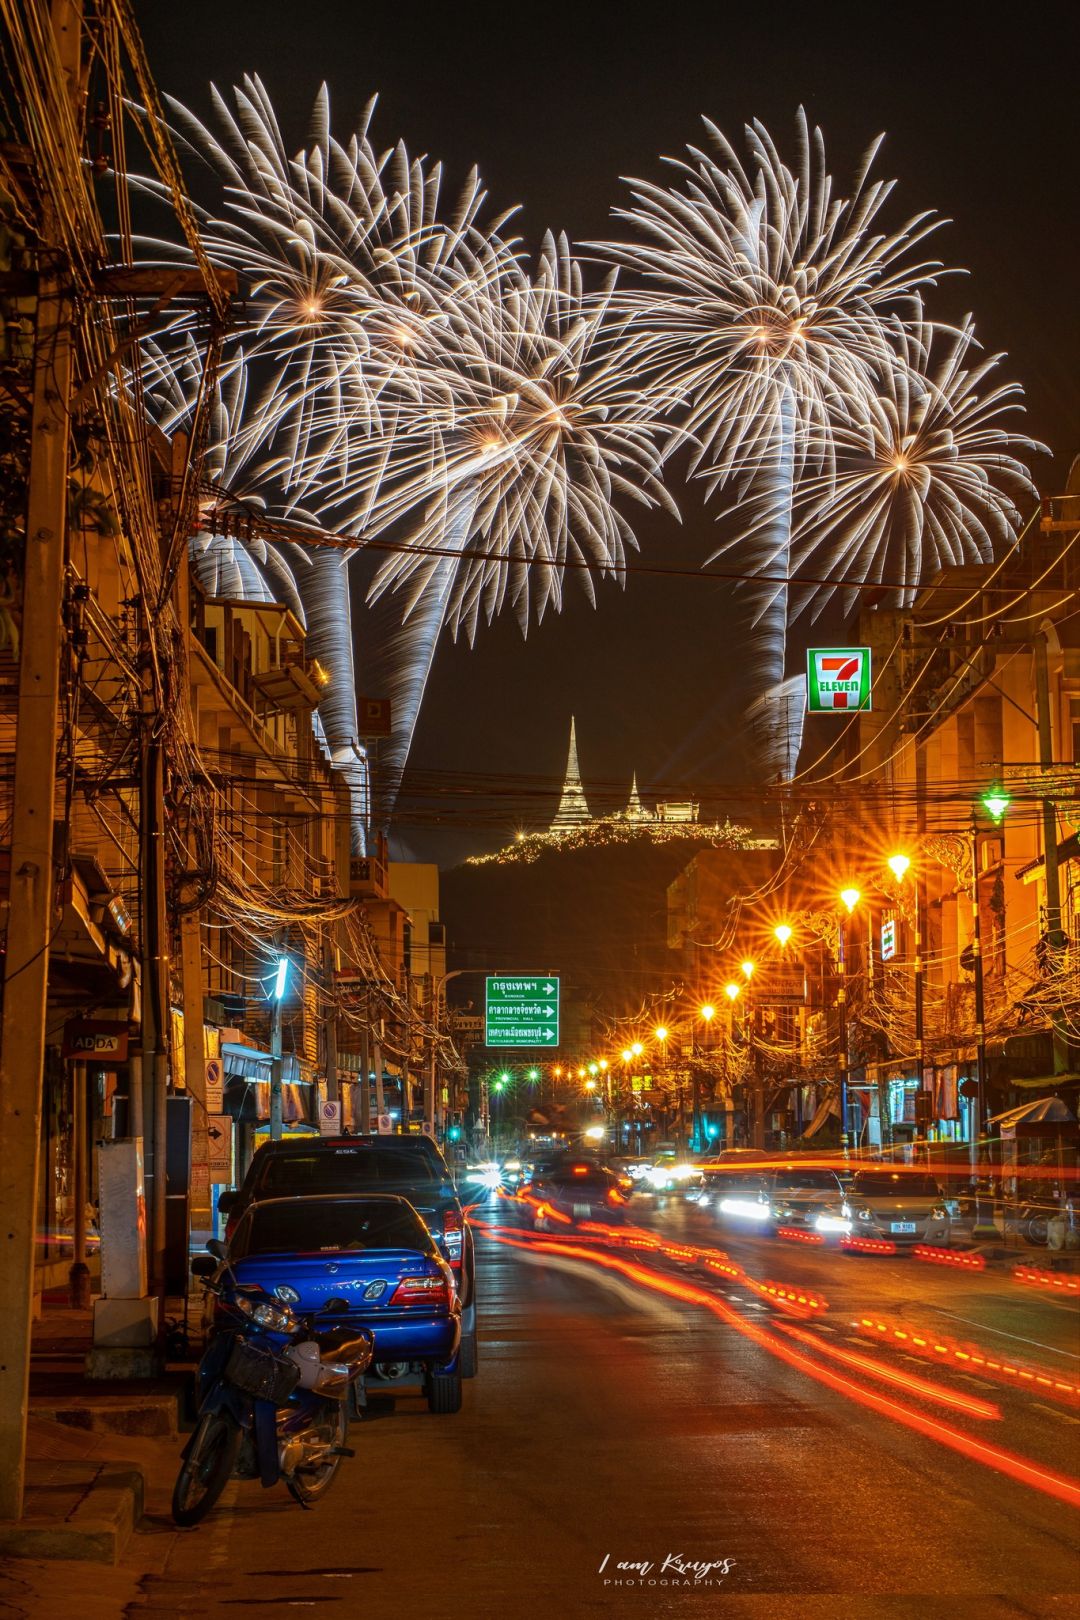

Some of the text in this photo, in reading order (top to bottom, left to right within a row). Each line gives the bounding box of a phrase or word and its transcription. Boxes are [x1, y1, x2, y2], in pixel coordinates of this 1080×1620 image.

[822, 658, 859, 708] 7
[492, 982, 537, 995] กรุงเทพฯ
[488, 1002, 542, 1015] ศาลากลางจังหวัด
[74, 1036, 114, 1049] ADDA
